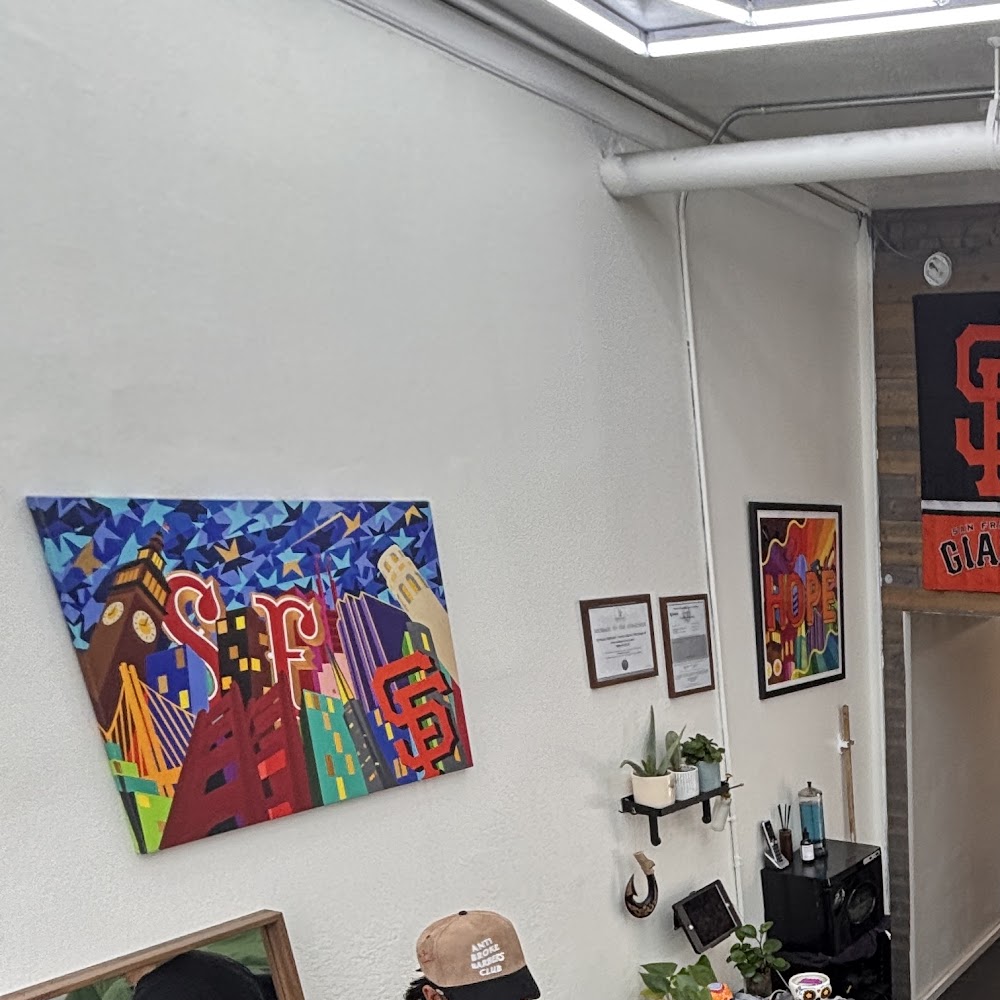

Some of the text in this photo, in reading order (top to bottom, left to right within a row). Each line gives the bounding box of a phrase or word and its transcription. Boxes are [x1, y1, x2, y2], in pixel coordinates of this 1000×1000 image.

[952, 524, 974, 536] SAN
[764, 570, 837, 632] HOPE
[471, 943, 500, 961] BROKE
[479, 964, 502, 976] CLUB
